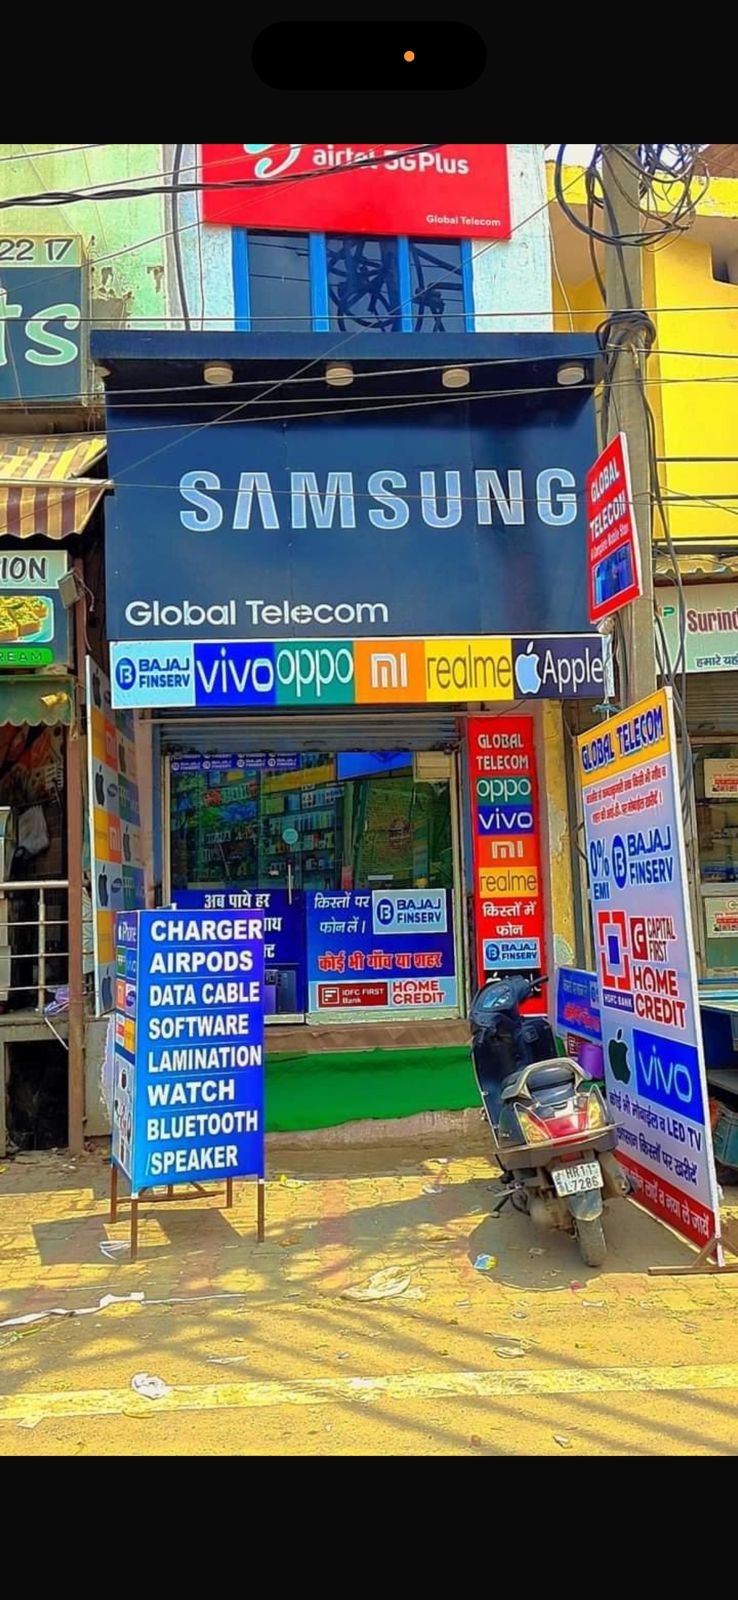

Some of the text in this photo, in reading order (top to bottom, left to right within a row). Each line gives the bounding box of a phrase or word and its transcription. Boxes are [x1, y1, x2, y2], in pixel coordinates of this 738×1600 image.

[426, 214, 501, 226] Global Telecom
[45, 239, 73, 260] 17
[591, 457, 620, 503] GLOBAL
[179, 468, 578, 532] SAMSUNG
[0, 556, 46, 580] ION
[125, 600, 389, 626] Global Telecom
[139, 657, 190, 672] BAJAJ
[196, 647, 274, 693] vivo
[427, 645, 511, 689] realme
[542, 648, 603, 693] Apple
[696, 654, 721, 668] हमारे
[139, 673, 190, 688] FINSERV
[478, 733, 523, 749] GLOBAL
[581, 704, 664, 771] GLOBAL TELECOM
[476, 755, 529, 770] TELECOM
[479, 808, 533, 830] vivo
[627, 826, 672, 857] BAJAJ
[590, 838, 610, 878] 0%
[480, 869, 537, 892] realme
[629, 857, 673, 885] FINSERV
[204, 893, 225, 908] अब
[255, 893, 271, 909] हर
[314, 891, 371, 909] किस्तों पर
[593, 881, 610, 900] EMI
[397, 898, 441, 910] BAJAJ
[483, 901, 536, 918] किस्तों में
[319, 916, 345, 935] फोन
[346, 916, 359, 934] लें
[397, 911, 442, 924] FINSERV
[647, 916, 676, 940] CAPITAL
[150, 918, 264, 942] CHARGER
[496, 923, 523, 938] फोन
[501, 943, 537, 951] BAJAJ
[501, 951, 538, 961] FINSERV
[648, 940, 669, 963] FIRST
[150, 950, 253, 974] AIRPODS
[319, 951, 345, 973] कोई
[348, 951, 365, 970] भी
[414, 951, 443, 969] शहर
[393, 980, 439, 992] HOME
[632, 965, 678, 996] HOME
[150, 984, 197, 1007] DATA
[202, 981, 261, 1005] CABLE
[392, 991, 445, 1005] CREDIT
[635, 993, 686, 1028] CREDIT
[149, 1014, 249, 1040] SOFTWARE
[148, 1045, 262, 1073] LAMINATION
[638, 1044, 693, 1103] vivo
[147, 1079, 235, 1106] WATCH
[147, 1110, 259, 1141] BLUETOOTH
[667, 1119, 686, 1144] LED
[687, 1127, 702, 1151] TV
[145, 1145, 239, 1176] /SPEAKER
